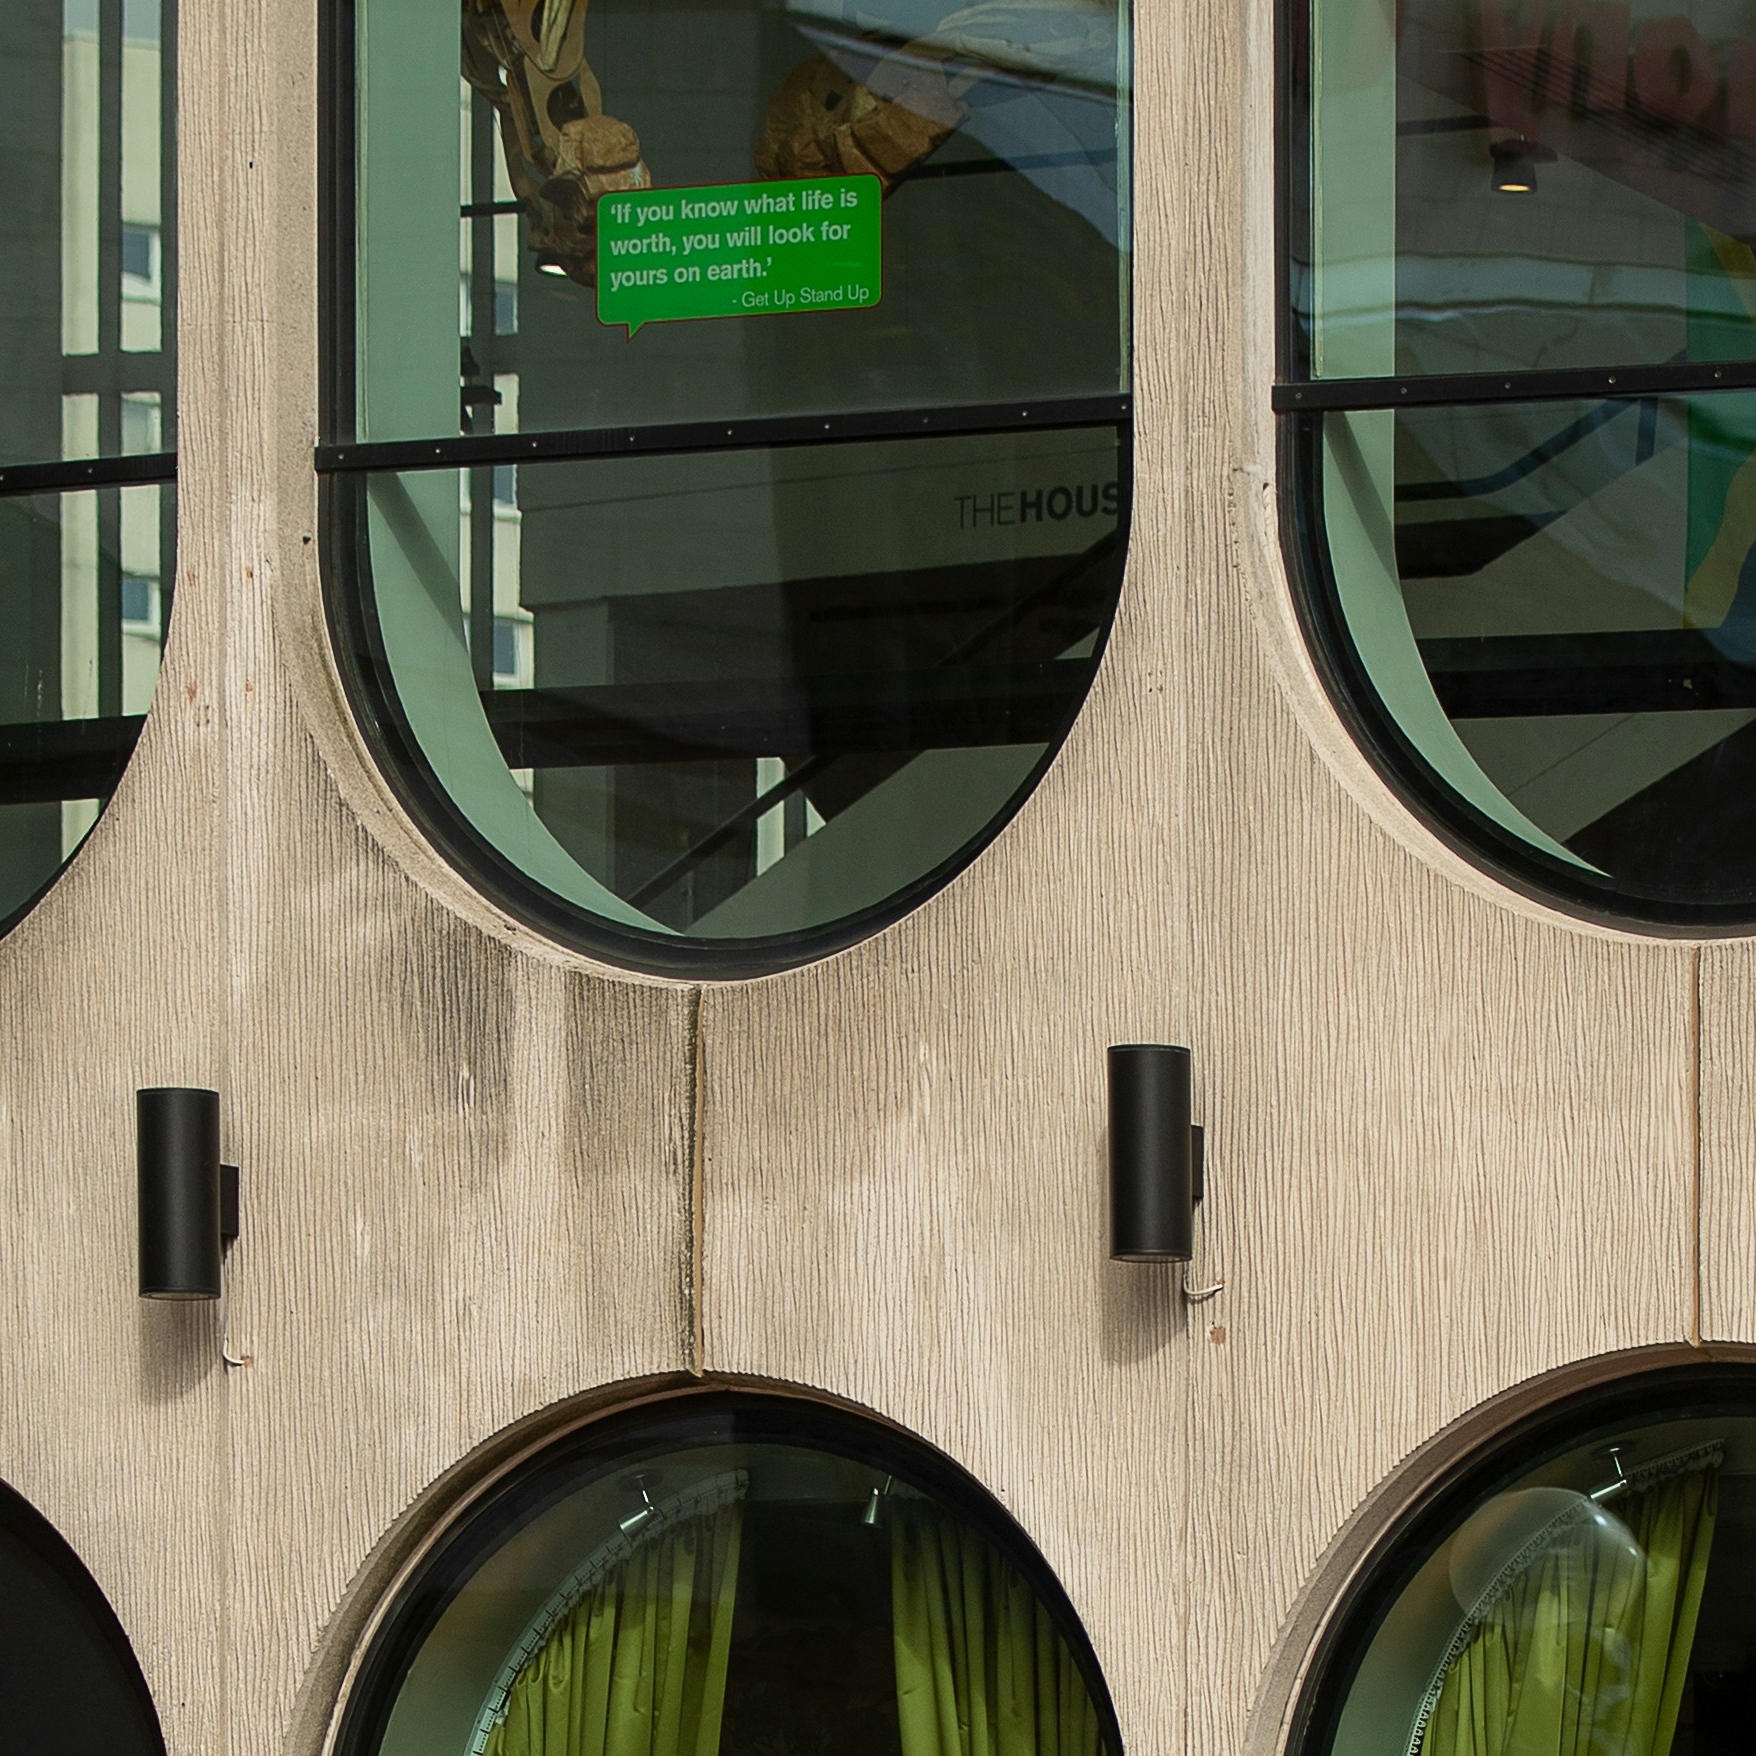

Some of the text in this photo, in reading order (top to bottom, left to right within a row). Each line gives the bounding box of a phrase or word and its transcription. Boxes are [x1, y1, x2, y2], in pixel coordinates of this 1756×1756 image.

[636, 205, 675, 227] you
[680, 199, 738, 220] know
[744, 192, 795, 213] what
[801, 189, 834, 211] life
[839, 188, 858, 208] is
[610, 221, 851, 256] worth, you will look for
[610, 266, 668, 292] yours
[673, 265, 701, 283] on
[741, 291, 770, 308] Get
[773, 289, 796, 309] Up
[799, 286, 843, 303] Stand
[847, 286, 870, 305] Up
